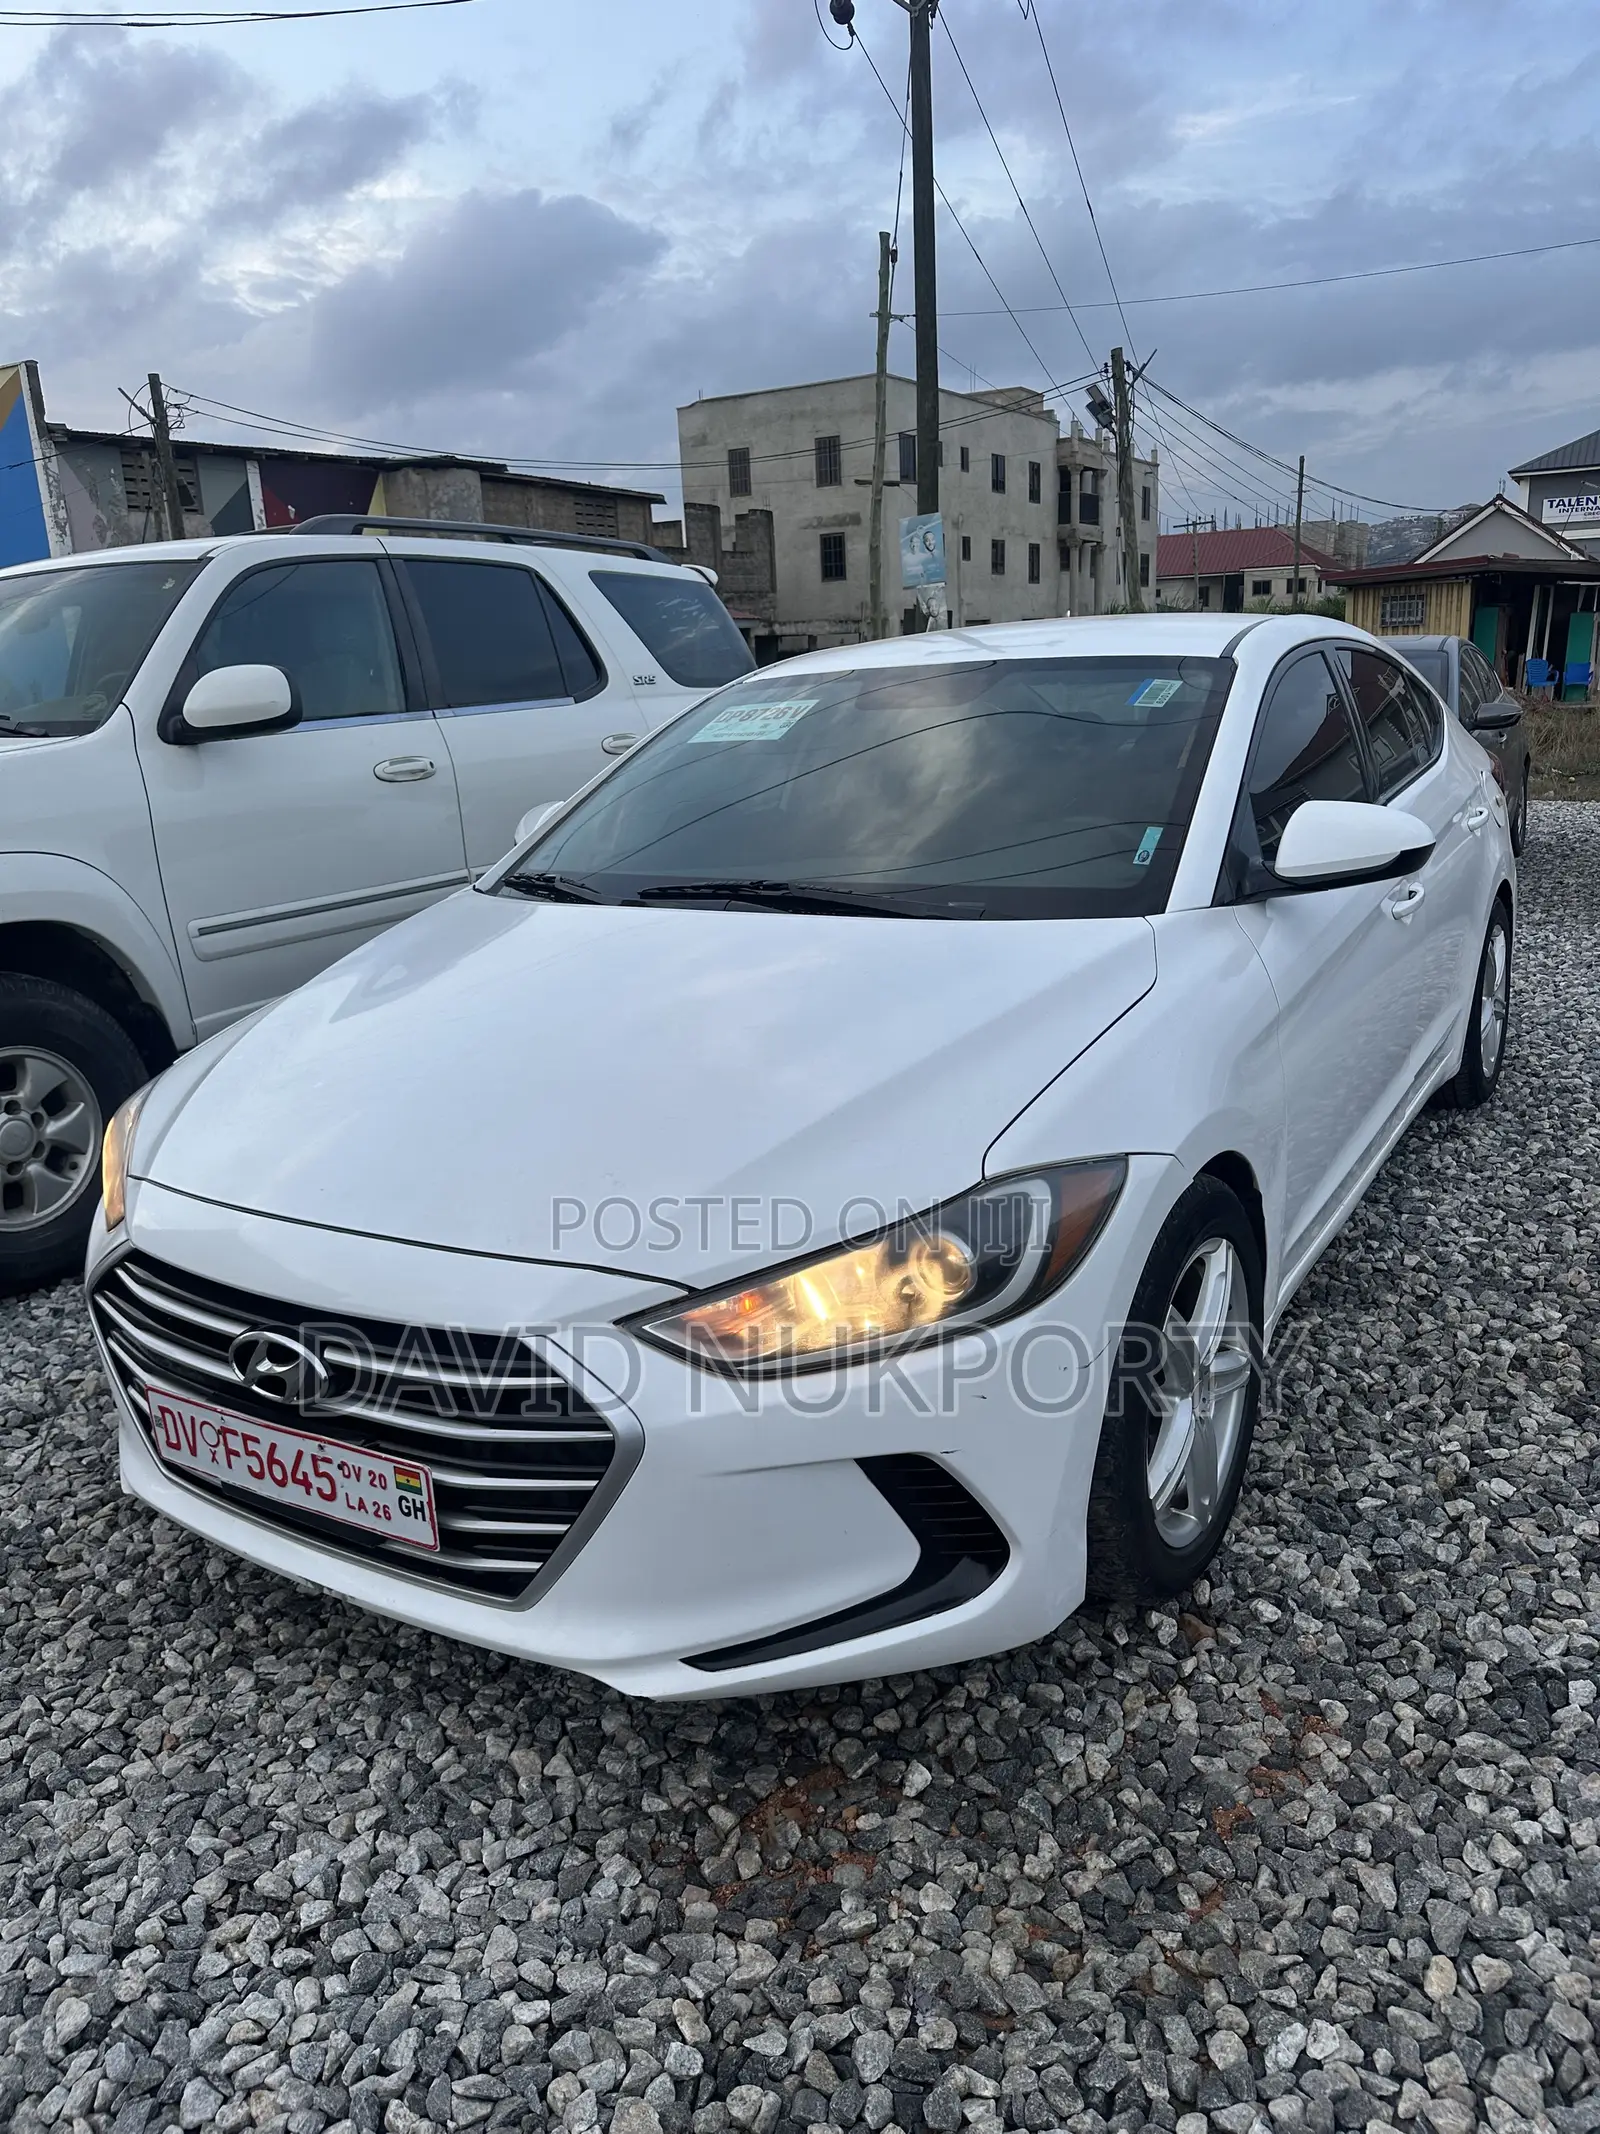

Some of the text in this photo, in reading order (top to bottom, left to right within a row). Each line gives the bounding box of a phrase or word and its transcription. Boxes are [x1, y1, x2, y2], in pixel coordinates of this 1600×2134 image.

[1547, 496, 1600, 508] TALEN
[633, 675, 656, 685] SR5
[157, 1405, 198, 1458] DV
[340, 1461, 388, 1490] DV 20
[345, 1492, 392, 1521] LA 26
[398, 1495, 427, 1522] GH
